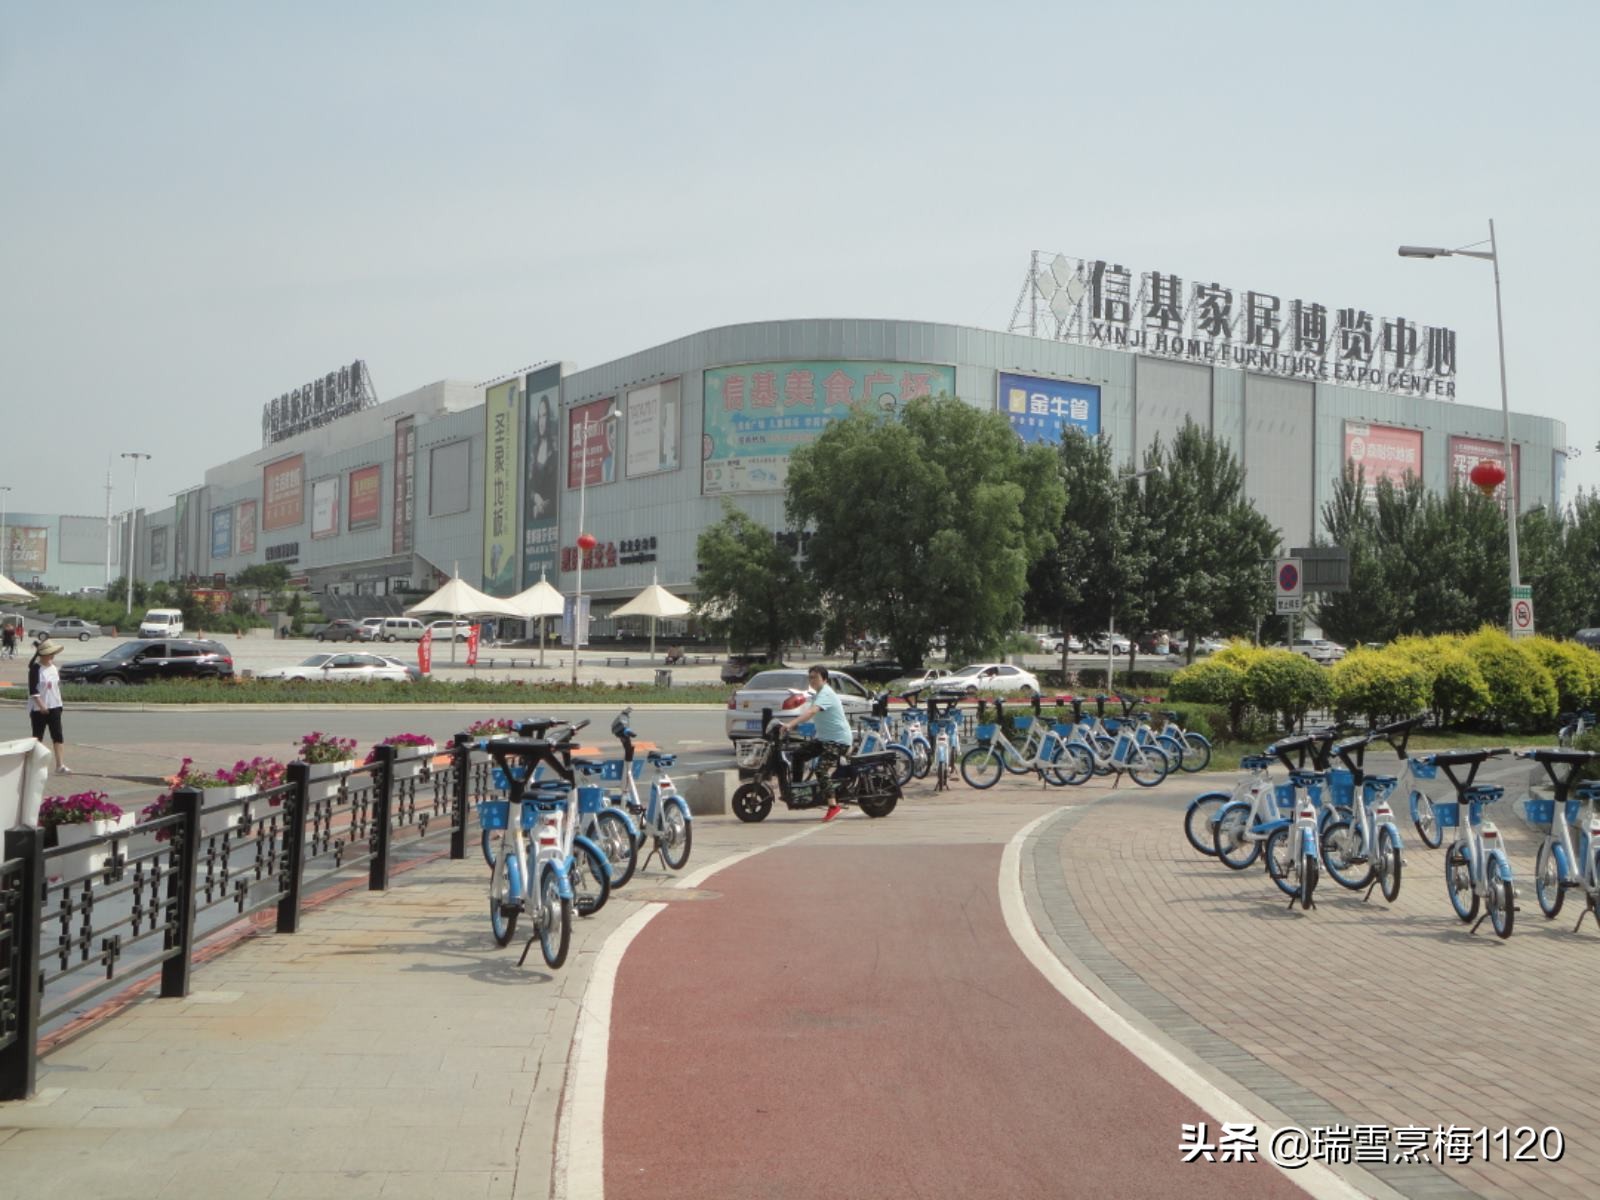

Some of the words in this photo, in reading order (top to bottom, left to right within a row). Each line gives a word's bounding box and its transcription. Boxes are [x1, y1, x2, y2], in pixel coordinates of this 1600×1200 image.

[1092, 260, 1456, 377] 信基家居博览中心
[722, 368, 933, 412] 信基美食广场
[1091, 323, 1146, 348] XINJI
[1155, 333, 1212, 360] HOME
[1221, 343, 1329, 377] FURNITURE
[1334, 361, 1381, 385] EXPO
[1387, 371, 1456, 398] CENTER
[1030, 393, 1089, 420] 金牛管
[493, 412, 506, 538] 圣象地板
